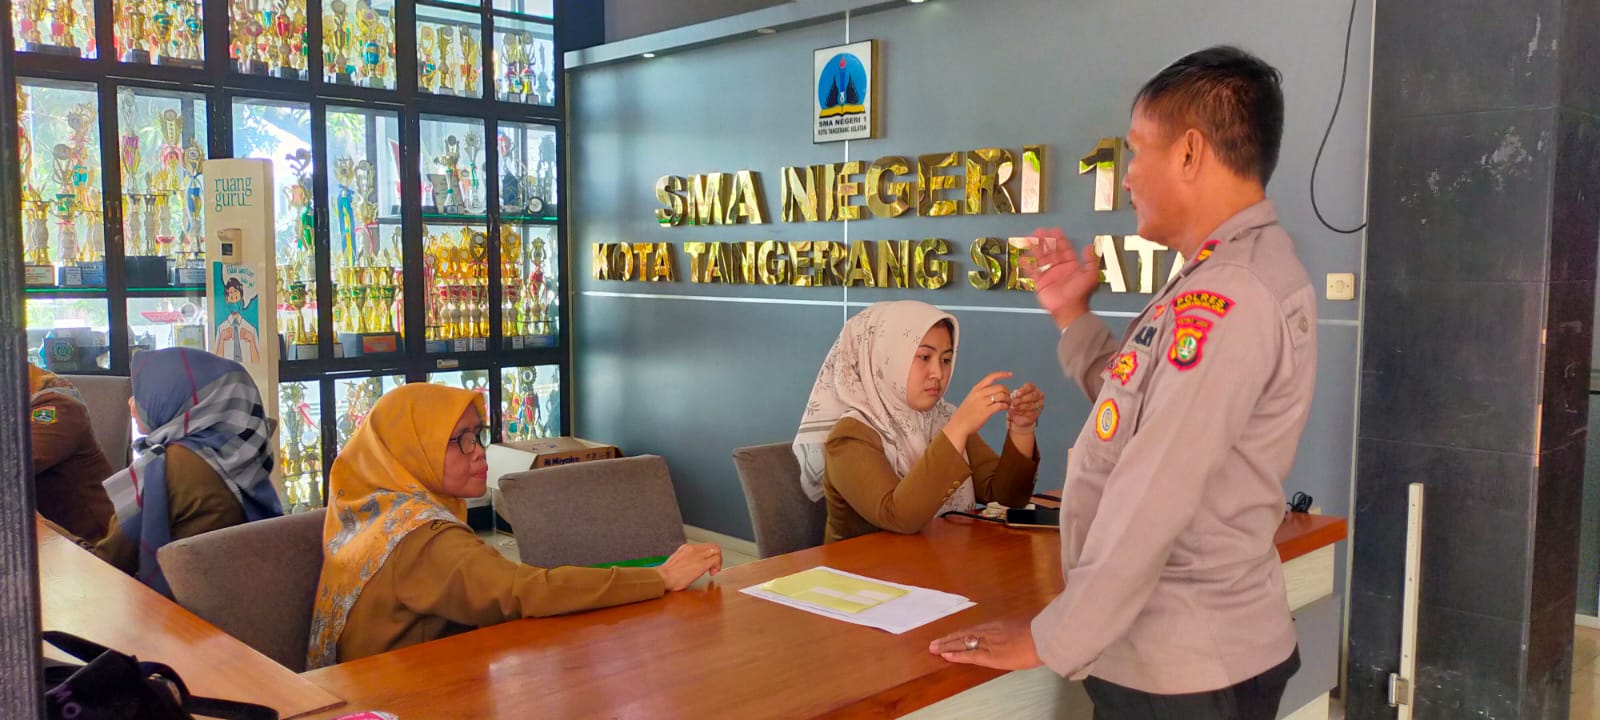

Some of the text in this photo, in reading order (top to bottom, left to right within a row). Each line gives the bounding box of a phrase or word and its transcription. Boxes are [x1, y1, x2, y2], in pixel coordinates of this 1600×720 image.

[818, 119, 834, 128] SMA
[835, 117, 861, 126] NEGERI
[214, 176, 252, 197] ruang
[655, 138, 1120, 228] SMA NEGERI 1
[592, 234, 1186, 294] KOTA TANGERANG SEAT
[1175, 292, 1227, 310] POLRES
